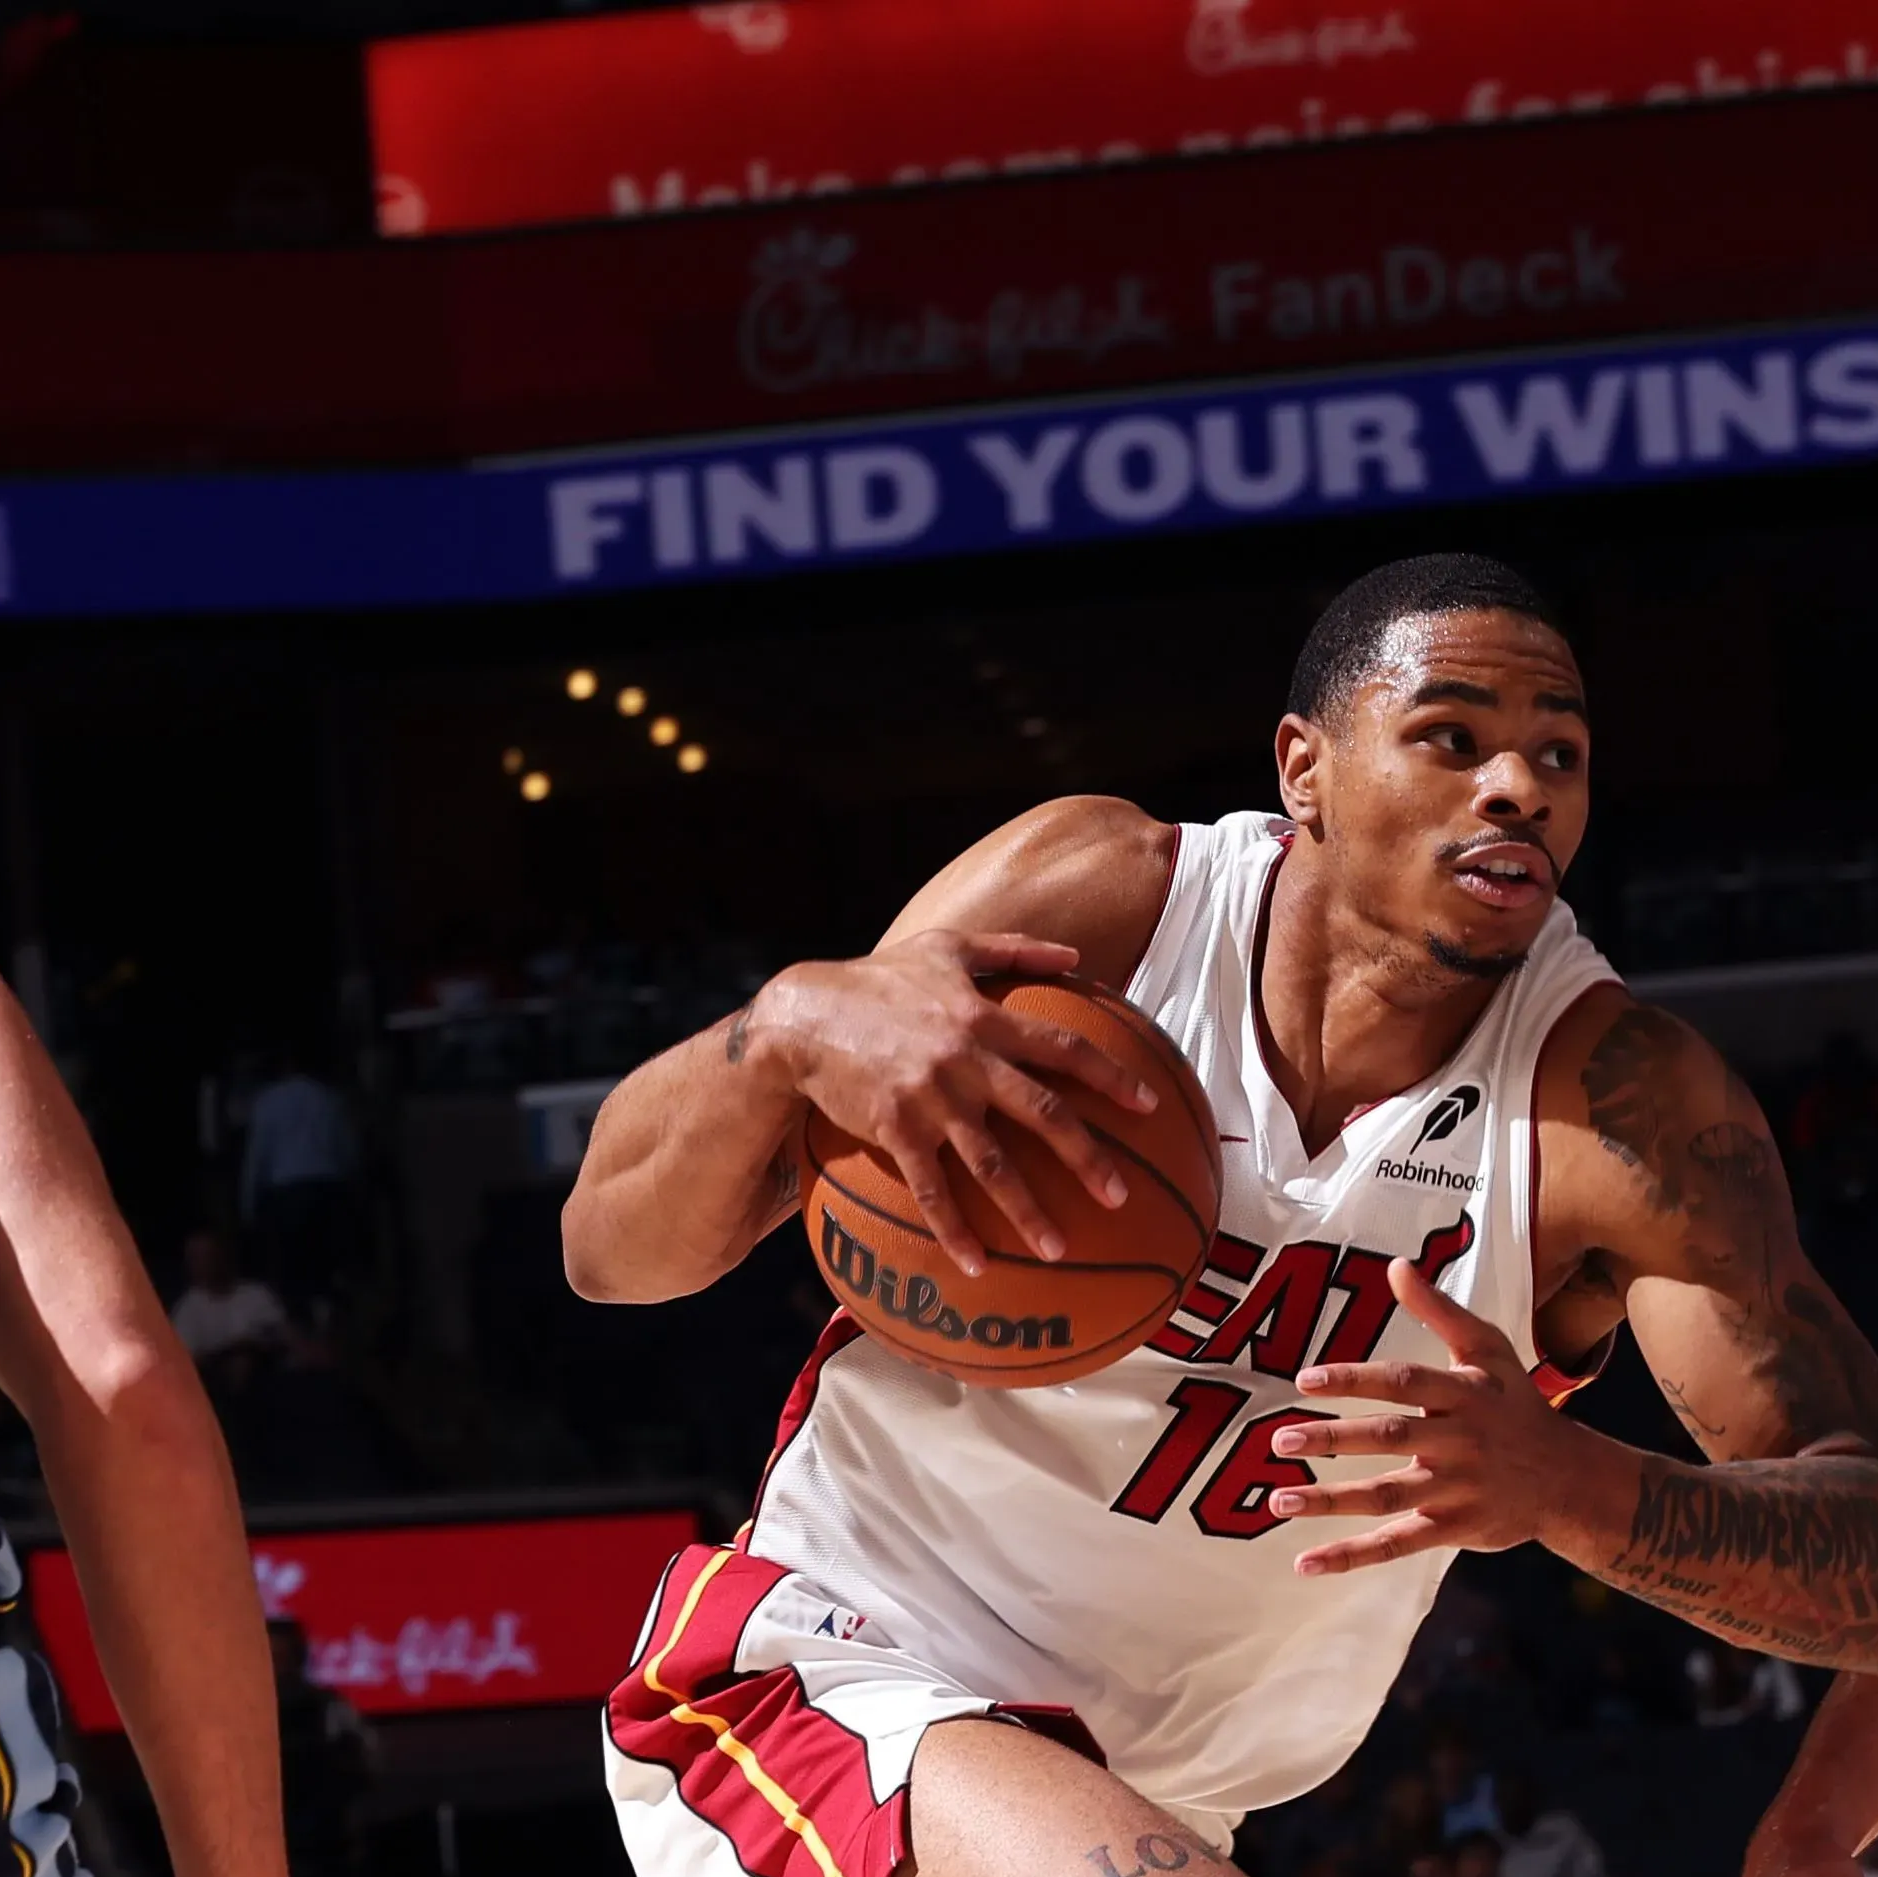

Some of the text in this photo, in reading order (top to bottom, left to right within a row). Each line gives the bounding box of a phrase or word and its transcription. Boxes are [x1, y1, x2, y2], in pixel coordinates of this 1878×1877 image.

[1210, 222, 1627, 342] FanDeck
[548, 443, 940, 581] FIND
[966, 388, 1431, 534] YOUR
[1375, 1158, 1485, 1191] Robinhood
[823, 1203, 1074, 1350] Wilson
[1109, 1376, 1341, 1540] 16
